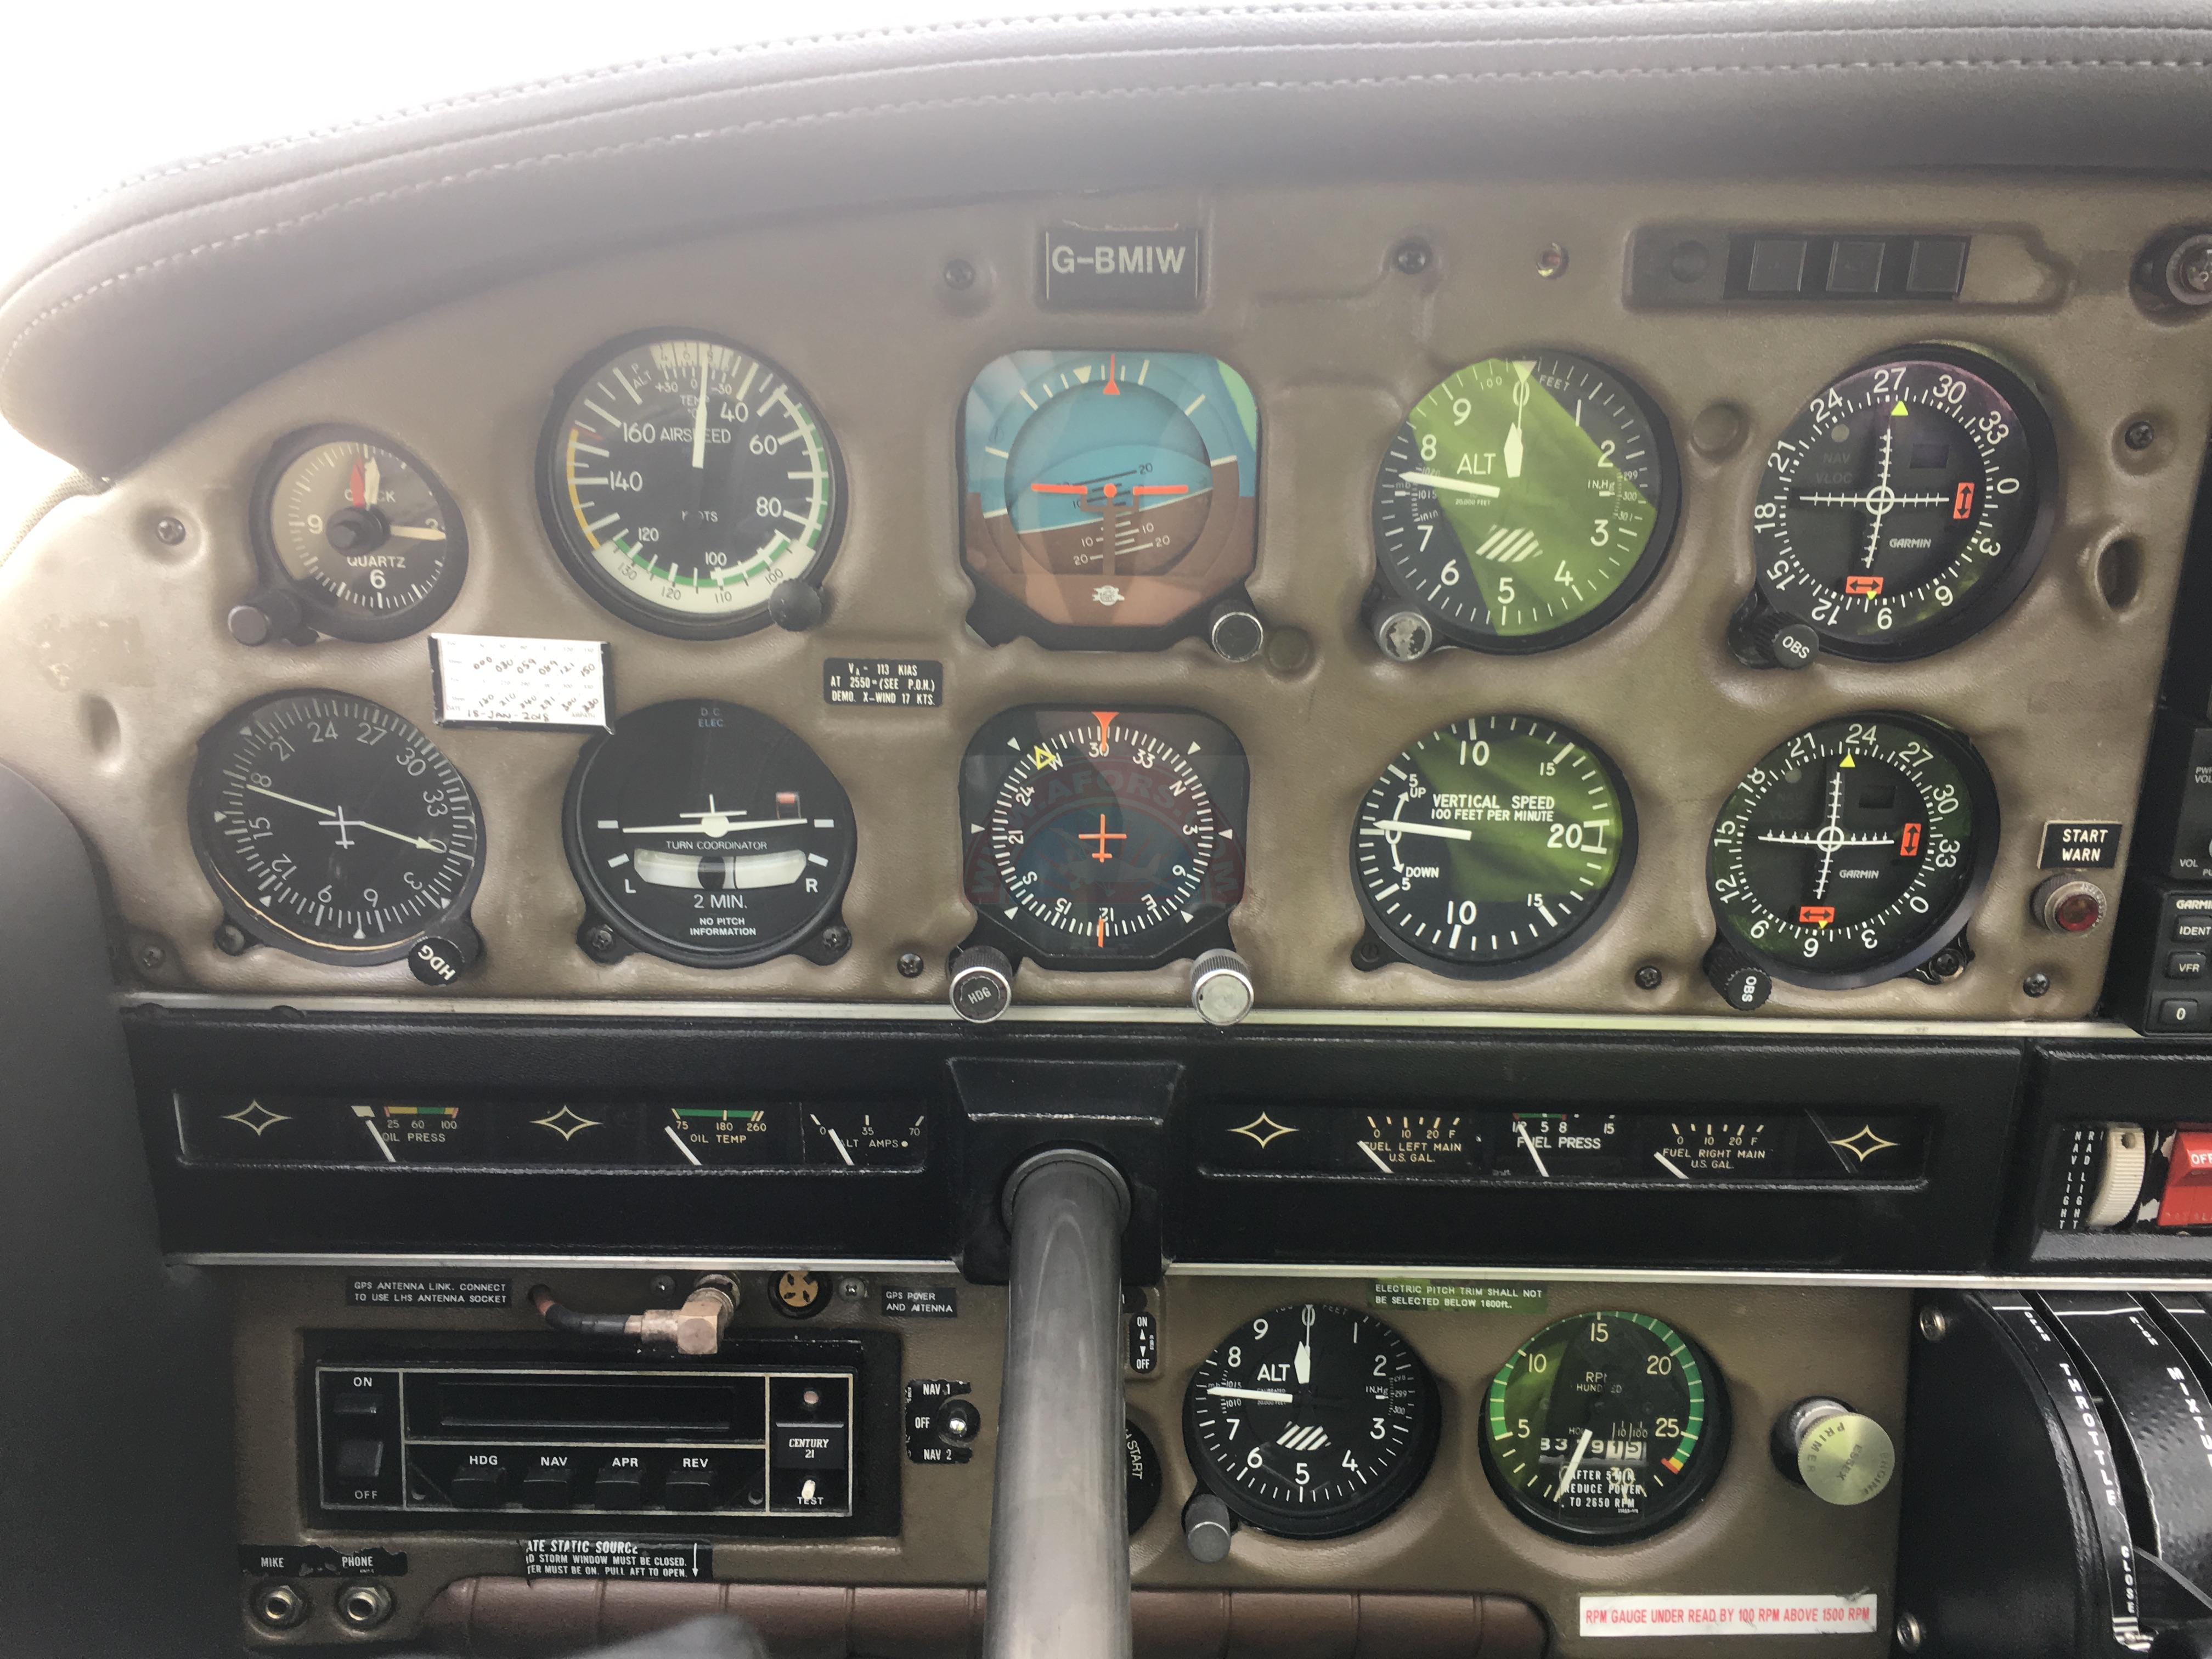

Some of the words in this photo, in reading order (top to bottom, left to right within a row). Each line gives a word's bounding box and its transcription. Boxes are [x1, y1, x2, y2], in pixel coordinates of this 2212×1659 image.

[1051, 245, 1186, 274] G-BMIW
[1539, 375, 1570, 391] FEET
[1873, 367, 1906, 393] 27
[720, 403, 748, 422] 40
[1453, 398, 1471, 425] 9
[622, 423, 655, 444] 160
[660, 428, 731, 442] AIRSEED
[749, 435, 778, 455] 60
[1457, 453, 1496, 475] ALT
[756, 497, 782, 517] 80
[638, 528, 659, 541] 120
[1155, 535, 1170, 548] 20
[1889, 538, 1931, 549] GARMIN
[347, 556, 406, 568] QUARTZ
[369, 570, 386, 589] 6
[714, 592, 732, 603] 110
[1782, 635, 1810, 659] OBS
[877, 664, 889, 675] 113
[898, 664, 918, 676] KIAS
[830, 675, 841, 687] AT
[879, 678, 899, 690] (SEE
[832, 690, 856, 702] DEMO.
[863, 691, 896, 704] X-WIND
[901, 693, 910, 704] 17
[307, 721, 338, 743] 24
[1845, 724, 1877, 745] 24
[1459, 740, 1489, 766] 10
[1409, 787, 1426, 798] UP
[1433, 794, 1500, 809] VERTICAL
[1511, 795, 1555, 810] SPEED
[1431, 809, 1451, 820] 100
[1454, 809, 1483, 821] FEET
[1487, 810, 1510, 821] PER
[1514, 810, 1554, 822] MINUTE
[1547, 823, 1582, 848] 20
[2062, 829, 2108, 844] START
[665, 840, 693, 850] TURN
[696, 840, 768, 850] COORDINATOR
[2062, 848, 2101, 862] WARN
[2179, 859, 2198, 868] VOL
[1406, 867, 1440, 878] DOWN
[1839, 870, 1879, 879] GARMIN
[625, 879, 636, 893] L
[805, 878, 819, 893] R
[693, 894, 704, 909] 2
[710, 894, 747, 909] MIN.
[699, 917, 714, 926] NO
[717, 917, 745, 926] PITCH
[690, 927, 757, 936] INFORMATION
[2179, 926, 2211, 936] IDENT
[417, 945, 456, 981] HDG
[2179, 963, 2200, 973] VFR
[968, 986, 992, 1003] HDG
[1742, 976, 1757, 1002] OBS
[441, 1120, 458, 1130] 100
[715, 1122, 733, 1131] 180
[1603, 1123, 1615, 1135] 15
[407, 1133, 446, 1143] PRESS
[690, 1134, 709, 1143] OIL
[715, 1135, 747, 1144] TEMP
[869, 1138, 899, 1148] AMPS
[1558, 1137, 1601, 1149] PRESS
[1398, 1142, 1427, 1152] LEFT
[1434, 1143, 1462, 1152] MAIN
[1410, 1153, 1435, 1163] GAL.
[1663, 1148, 1691, 1158] FUEL
[1699, 1149, 1732, 1159] RIGHT
[1737, 1150, 1766, 1159] MAIN
[377, 1282, 425, 1290] ANTENNA
[429, 1283, 454, 1291] LINK.
[1375, 1284, 1422, 1293] ELECTRIC
[1426, 1285, 1455, 1295] PITCH
[1460, 1287, 1483, 1295] TRIM
[1487, 1288, 1518, 1297] SHALL
[1523, 1289, 1542, 1297] NOT
[417, 1294, 465, 1302] ANTENNA
[885, 1291, 903, 1299] GPS
[886, 1303, 906, 1311] AND
[1375, 1296, 1387, 1304] BE
[1391, 1297, 1440, 1306] SELECTED
[1444, 1298, 1476, 1307] BELOW
[1137, 1316, 1148, 1327] ON
[1590, 1323, 1609, 1342] 15
[1136, 1358, 1150, 1369] OFF
[1257, 1364, 1290, 1381] ALT
[353, 1377, 373, 1387] ON
[923, 1384, 941, 1395] NAV
[946, 1384, 951, 1395] 1
[915, 1418, 930, 1429] OFF
[1655, 1418, 1679, 1437] 25
[2059, 1363, 2117, 1506] THROTTLE
[788, 1438, 829, 1449] CENTURY
[805, 1449, 815, 1459] 21
[923, 1449, 942, 1460] NAV
[946, 1449, 952, 1460] 2
[1127, 1440, 1143, 1479] START
[469, 1455, 498, 1466] HDG
[540, 1457, 568, 1466] NAV
[612, 1457, 639, 1467] APR
[682, 1458, 708, 1468] REV
[354, 1490, 378, 1500] OFF
[797, 1497, 823, 1505] TEST
[1570, 1497, 1581, 1506] TO
[1585, 1498, 1610, 1508] 2650
[1615, 1498, 1635, 1508] RPM
[550, 1540, 589, 1554] STATIC
[261, 1556, 284, 1568] MIKE
[342, 1556, 374, 1567] PHONE
[539, 1554, 568, 1564] STORM
[573, 1555, 608, 1564] WINDOW
[613, 1556, 636, 1565] MUST
[640, 1557, 651, 1566] BE
[654, 1557, 687, 1566] CLOSED.
[544, 1565, 568, 1574] MUST
[571, 1566, 582, 1575] BE
[605, 1567, 625, 1576] PULL
[630, 1567, 645, 1576] AFT
[648, 1568, 658, 1577] TO
[663, 1568, 687, 1578] OPEN.
[2121, 1545, 2136, 1613] CLOSE
[1585, 1610, 1607, 1623] RPM
[1611, 1609, 1647, 1623] GAUGE
[1651, 1609, 1684, 1623] UNDER
[1688, 1609, 1716, 1622] READ
[1720, 1608, 1735, 1622] BY
[1739, 1608, 1755, 1622] 100
[1758, 1608, 1780, 1622] RPM
[1784, 1607, 1818, 1622] ABOVE
[1822, 1607, 1844, 1621] 1500
[1848, 1607, 1870, 1621] RPM
